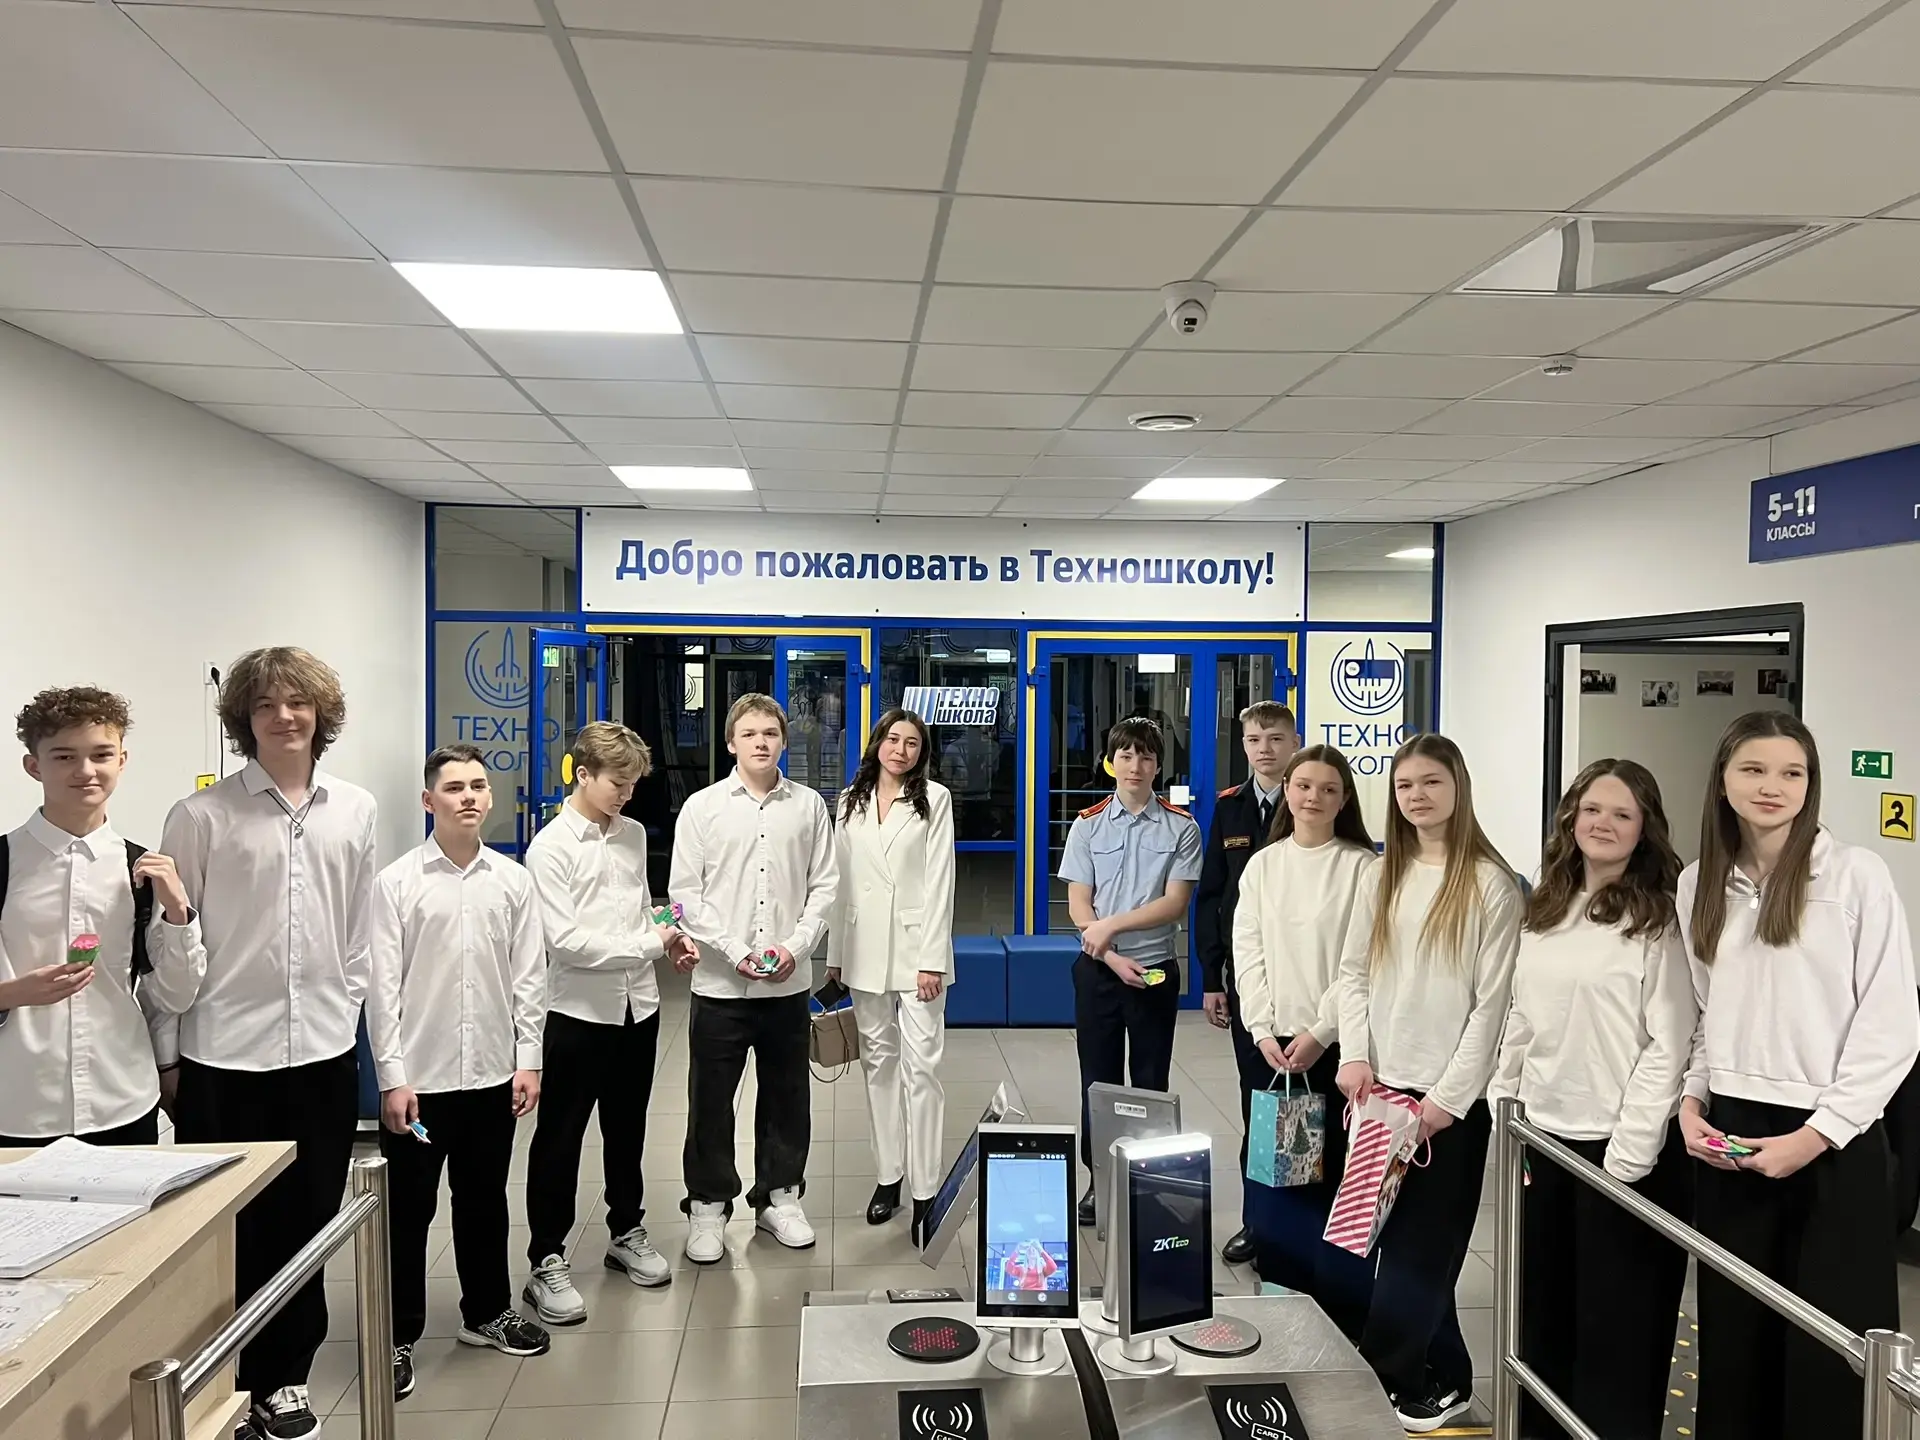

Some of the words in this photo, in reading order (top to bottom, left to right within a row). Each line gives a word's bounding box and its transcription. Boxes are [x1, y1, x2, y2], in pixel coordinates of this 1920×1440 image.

[1766, 520, 1816, 542] КЛАССЫ
[615, 538, 743, 585] Добро
[755, 551, 989, 582] пожаловать
[1000, 556, 1020, 582] в
[1029, 549, 1275, 594] Техношколу!
[938, 688, 999, 708] ТЕХНО
[1345, 755, 1394, 776] КОЛ
[1256, 1428, 1280, 1440] CARD
